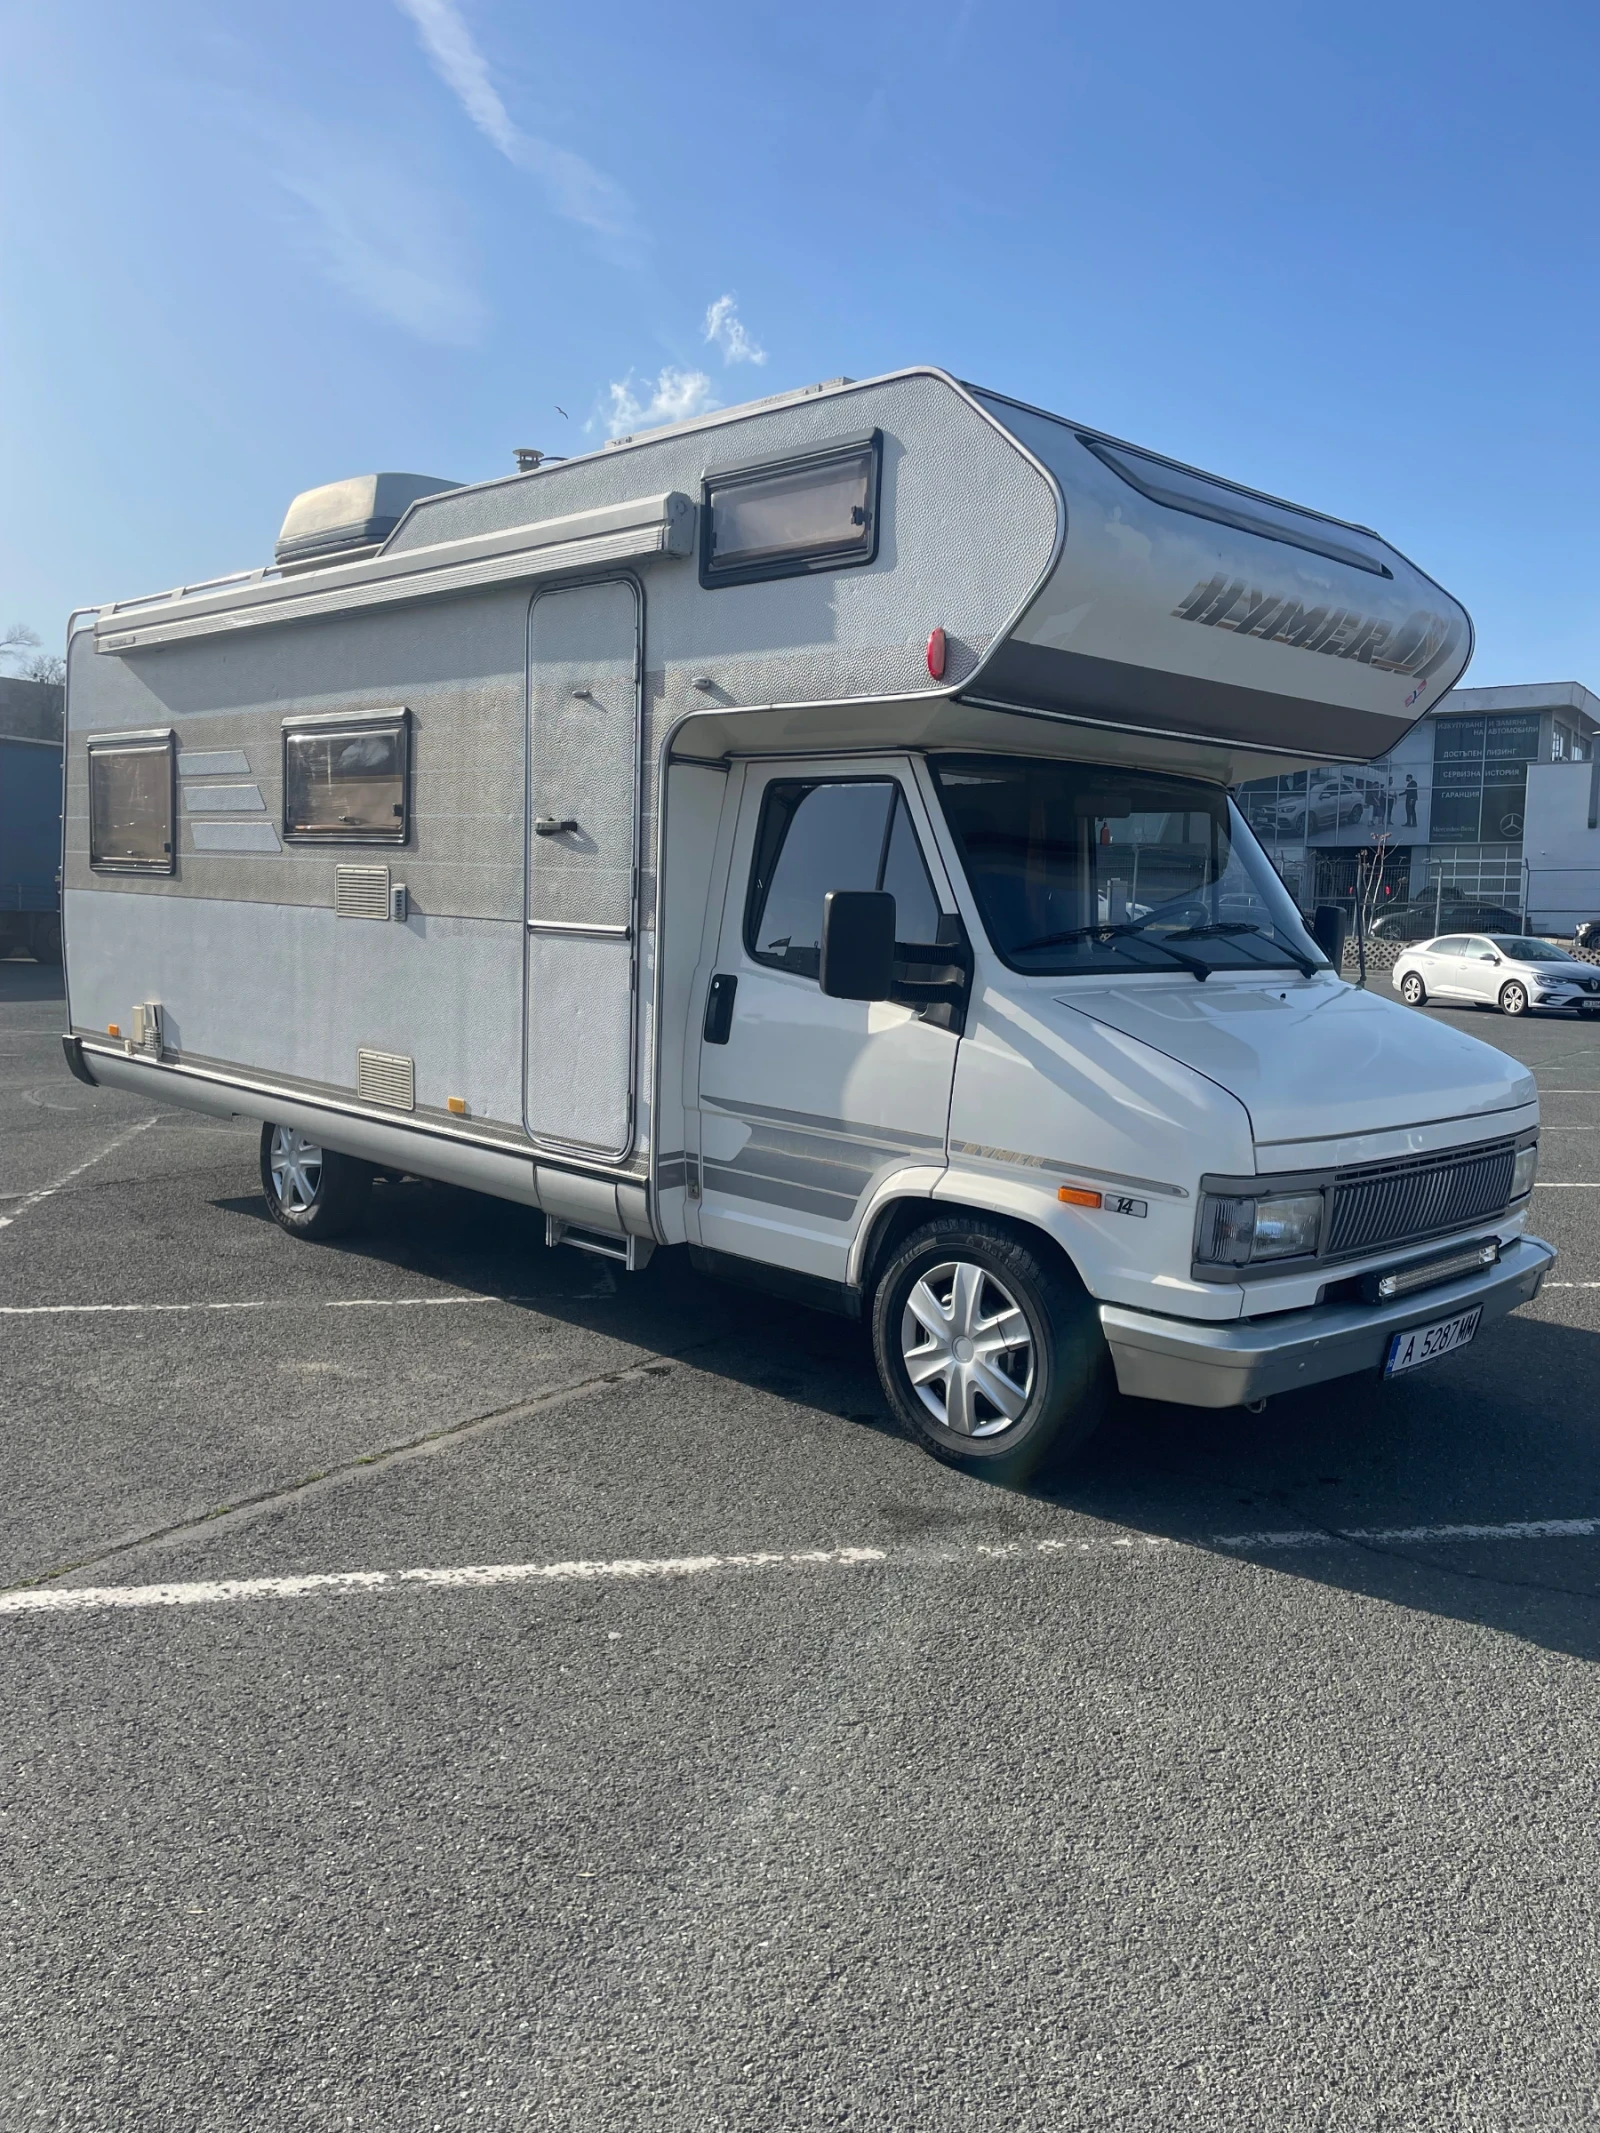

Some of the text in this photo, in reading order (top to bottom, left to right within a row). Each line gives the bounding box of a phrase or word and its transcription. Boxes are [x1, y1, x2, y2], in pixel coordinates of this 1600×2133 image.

[1171, 571, 1394, 665] HYMER
[1487, 726, 1539, 735] АВТОМОБИЛИ
[1443, 748, 1517, 758] ДОСТЪПЕН ЛИЗИНГ
[1443, 769, 1519, 778] СЕРВИЗНА ИСТОРИЯ
[1441, 791, 1480, 799] ГАРАНЦИЯ
[961, 1142, 1045, 1168] HYMER
[1116, 1197, 1134, 1215] 14
[1401, 1335, 1416, 1365] A
